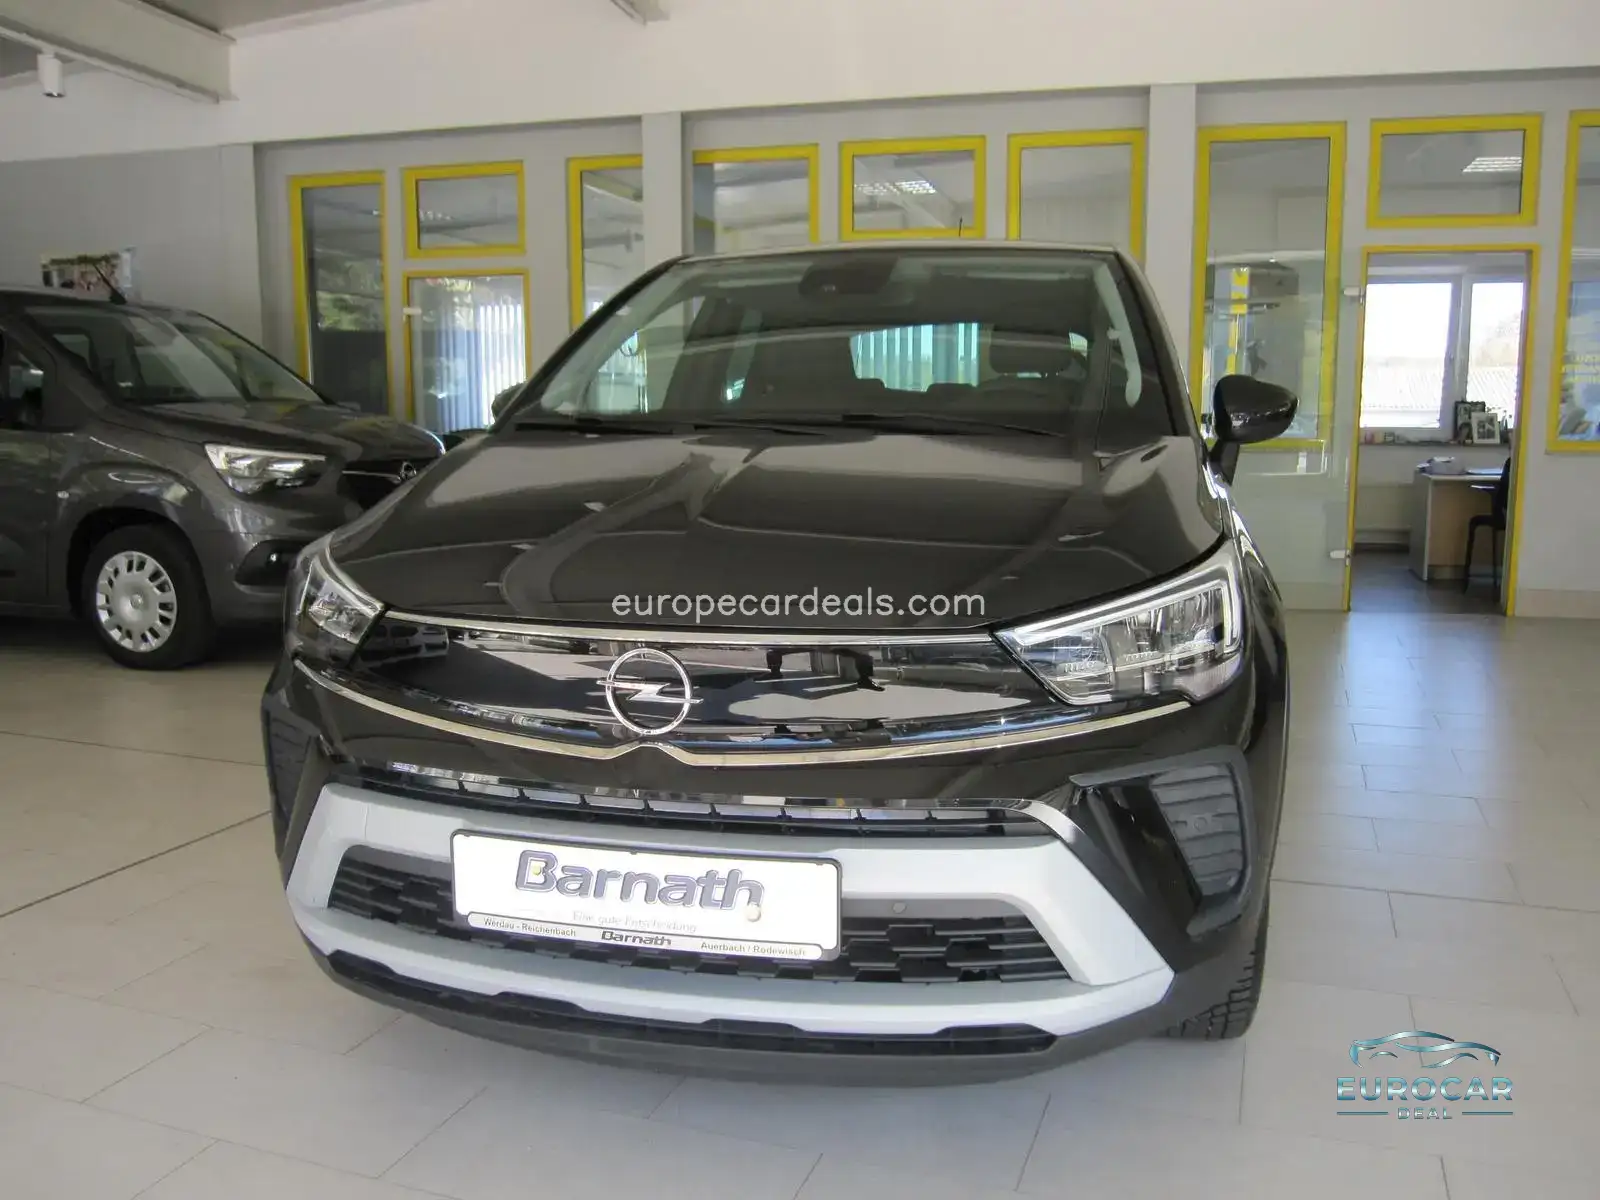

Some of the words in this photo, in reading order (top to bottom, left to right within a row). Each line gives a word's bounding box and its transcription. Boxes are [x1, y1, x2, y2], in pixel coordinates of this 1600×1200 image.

[515, 849, 765, 911] Barnath
[483, 917, 515, 930] Werdau
[521, 922, 577, 938] Reichenbach
[600, 930, 672, 947] Barnath
[700, 941, 746, 954] Auerbach
[753, 944, 806, 957] Rodewisch
